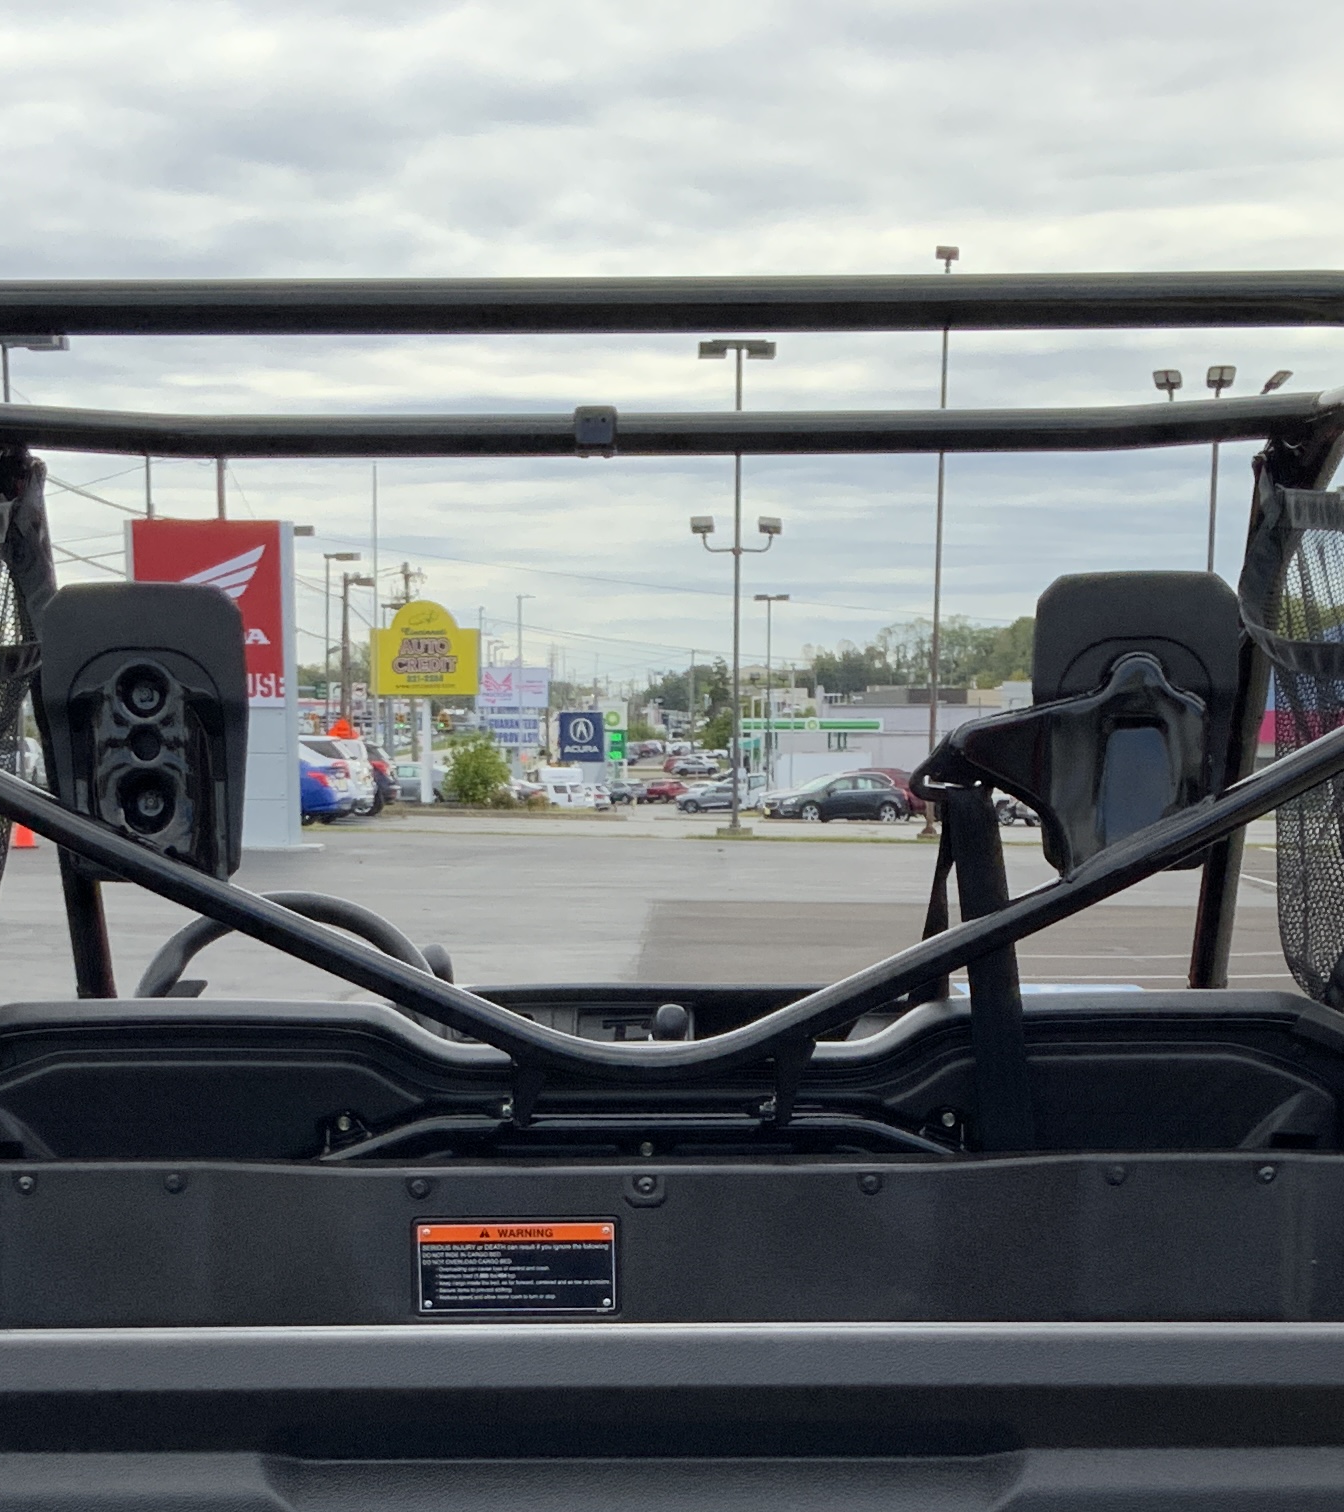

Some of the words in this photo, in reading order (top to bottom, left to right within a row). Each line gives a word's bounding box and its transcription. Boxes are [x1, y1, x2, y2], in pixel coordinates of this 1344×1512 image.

[398, 636, 451, 656] AUTO
[391, 655, 459, 675] CREDIT
[564, 745, 600, 753] ACURA
[497, 1228, 554, 1239] WARNING
